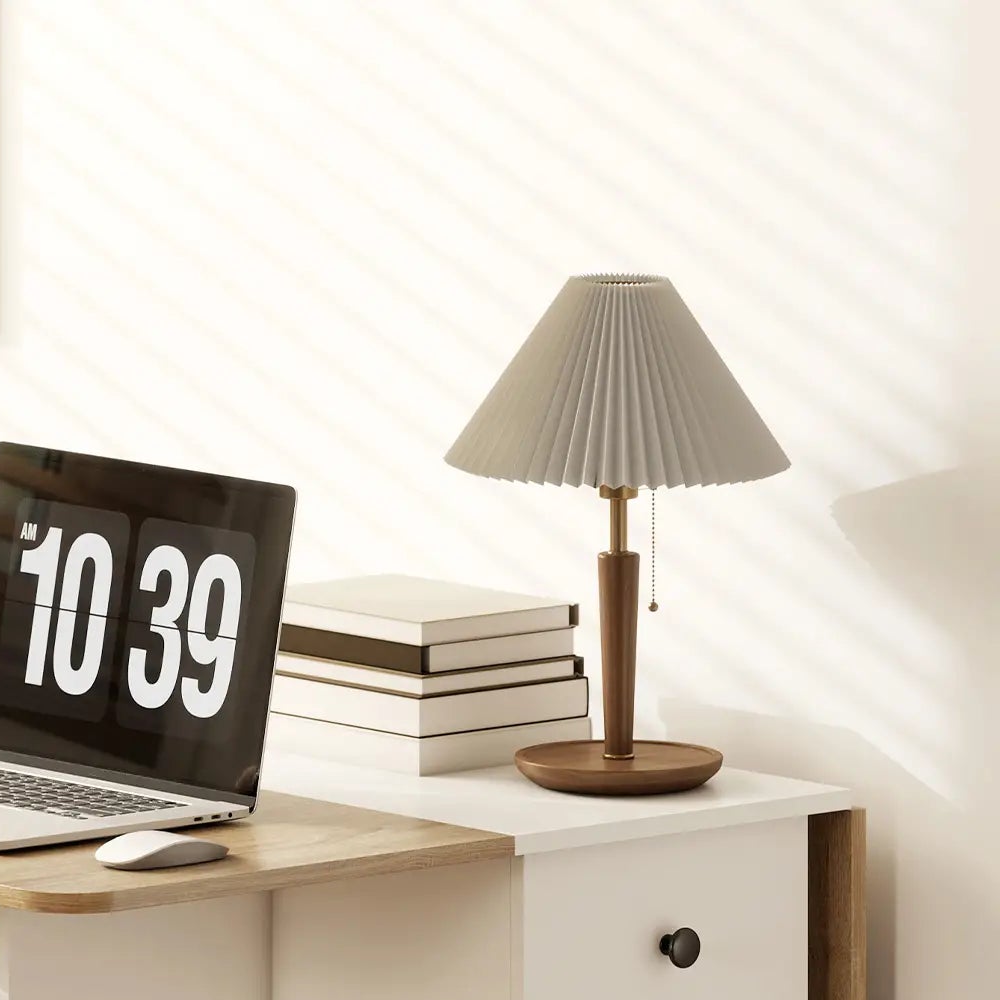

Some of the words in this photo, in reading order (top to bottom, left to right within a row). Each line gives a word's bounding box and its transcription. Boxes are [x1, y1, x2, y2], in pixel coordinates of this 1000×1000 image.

[20, 522, 38, 541] AM
[20, 527, 113, 696] 10
[127, 545, 242, 718] 39
